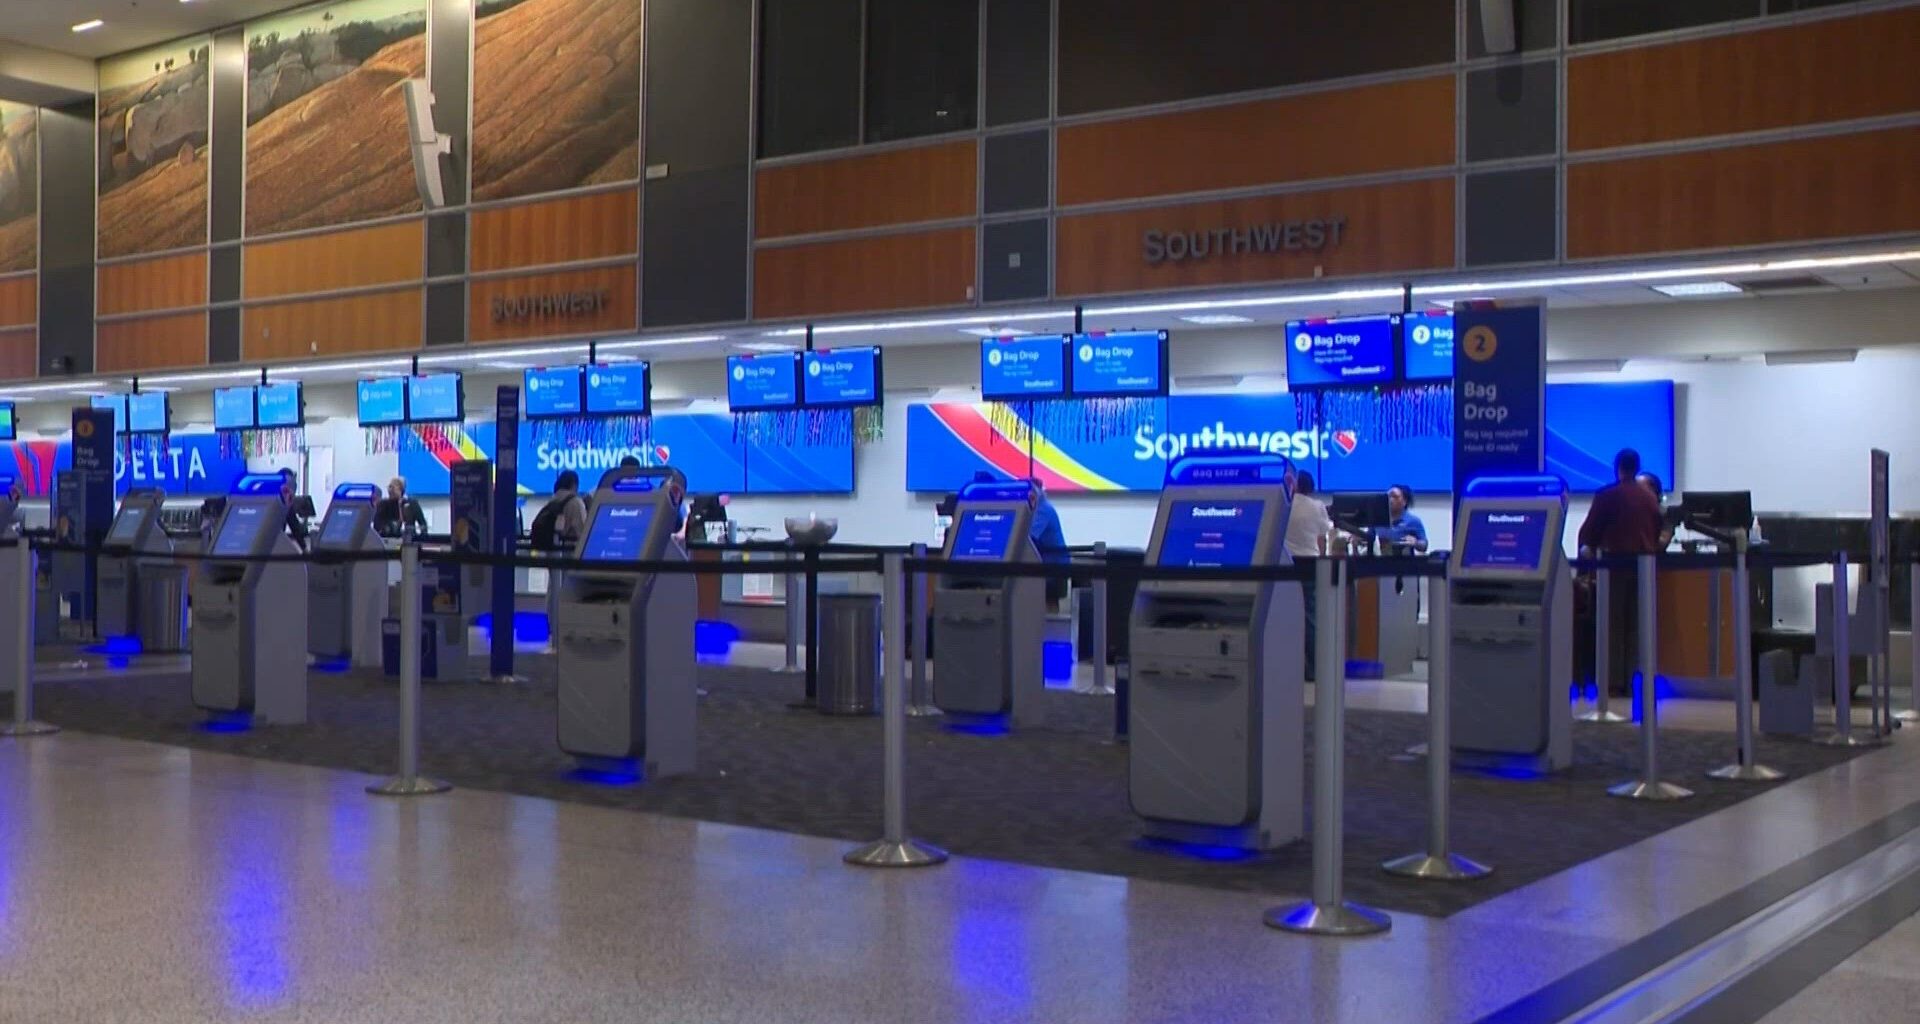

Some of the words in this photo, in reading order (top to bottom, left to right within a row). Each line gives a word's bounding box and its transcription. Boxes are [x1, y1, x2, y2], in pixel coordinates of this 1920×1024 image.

[1314, 335, 1333, 347] Bag
[1335, 333, 1361, 346] Drop
[1003, 351, 1018, 363] Bag
[1019, 350, 1040, 361] Drop
[1095, 347, 1111, 359] Bag
[1112, 347, 1134, 359] Drop
[1341, 366, 1380, 375] Southwest
[1464, 381, 1497, 402] Bag
[1464, 403, 1508, 424] Drop
[1192, 506, 1236, 517] Southwest
